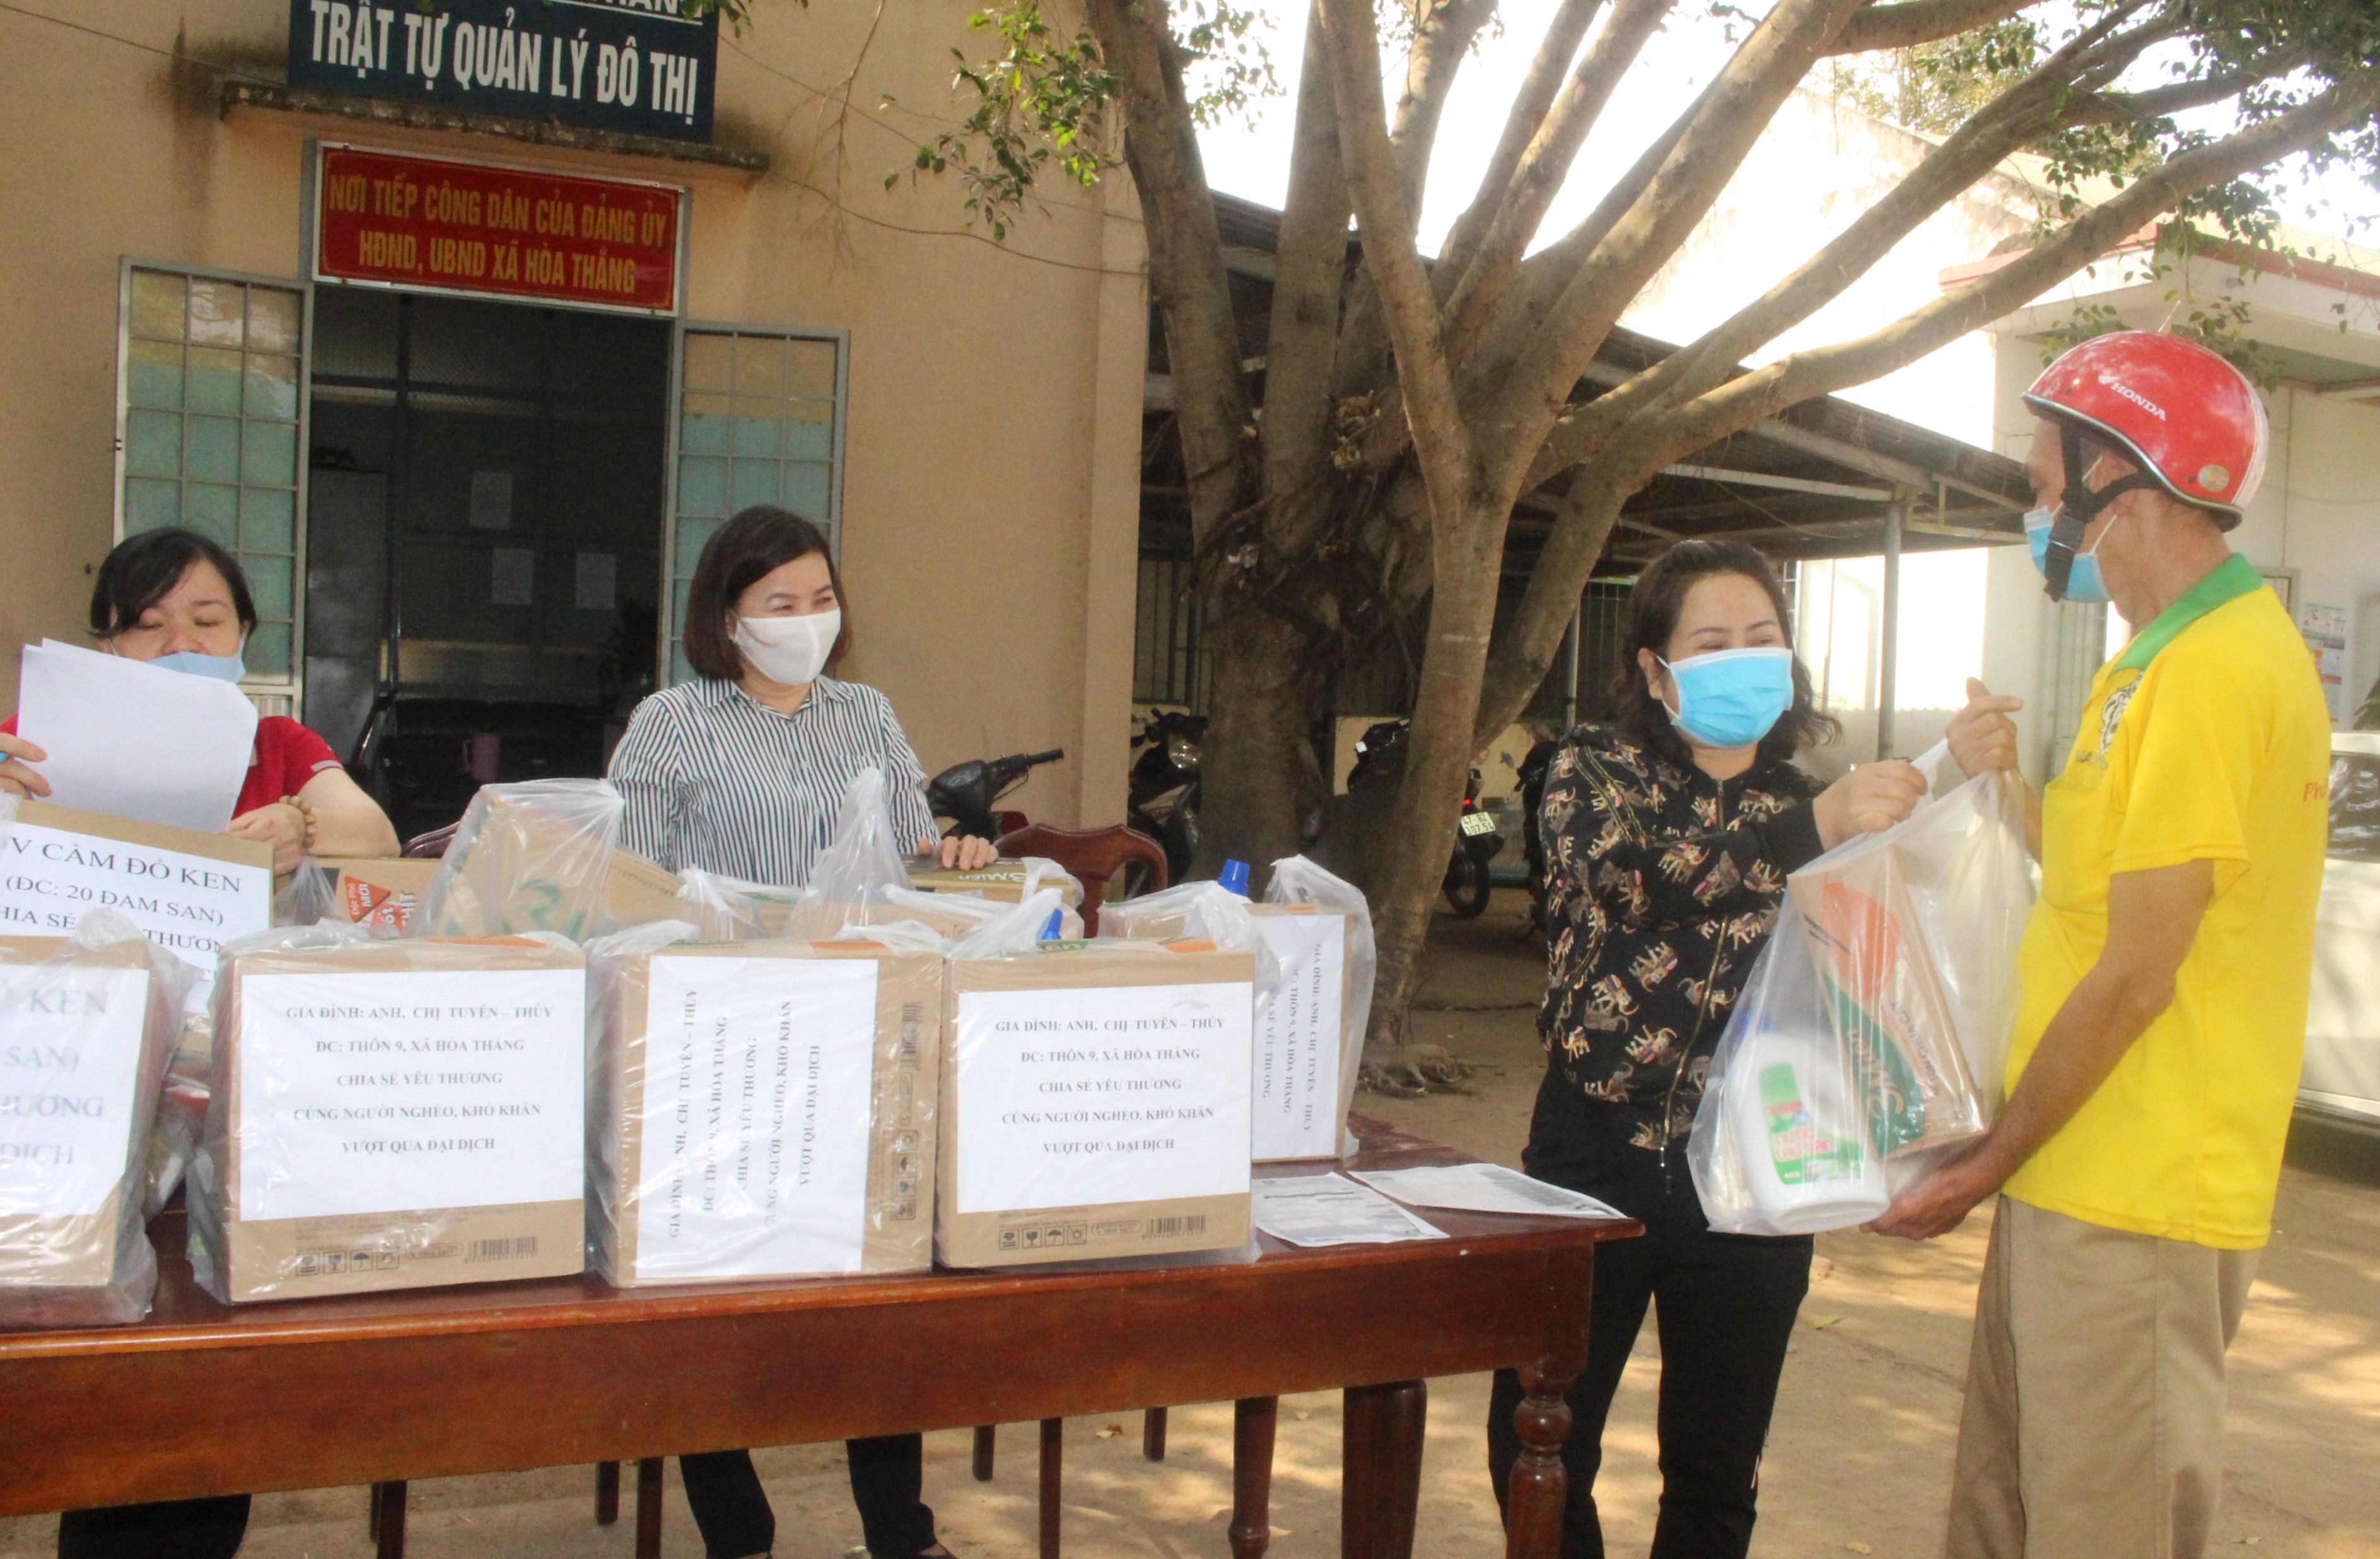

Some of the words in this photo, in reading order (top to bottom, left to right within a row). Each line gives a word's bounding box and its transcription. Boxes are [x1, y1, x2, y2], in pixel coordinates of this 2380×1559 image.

[310, 0, 394, 79] TRẬT
[404, 12, 450, 91] TỰ
[453, 6, 542, 93] QUẢN
[551, 28, 590, 100] LÝ
[597, 35, 639, 107] ĐÔ
[650, 51, 698, 126] THỊ
[329, 175, 368, 214] NƠI
[373, 172, 418, 218] TIẾP
[425, 179, 481, 226] CÔNG
[487, 188, 530, 232] DÂN
[536, 189, 576, 237] CỦA
[581, 192, 636, 245] ĐẢNG
[641, 199, 667, 247] ỦY
[429, 236, 486, 277] UBND
[491, 240, 519, 282] XÃ
[525, 242, 566, 286] HÒA
[571, 245, 636, 294] THẮNG
[2111, 381, 2167, 422] HONDA
[42, 842, 116, 870] CẦM
[125, 857, 170, 880] ĐỒ
[180, 867, 242, 894] KEN
[66, 884, 93, 902] 20
[166, 902, 224, 926] SAN)
[30, 988, 110, 1015] KEN
[286, 1007, 315, 1019] GIA
[995, 1020, 1020, 1032] GIA
[337, 1074, 376, 1086] CHIA
[1039, 1081, 1073, 1093] CHIA
[803, 1112, 815, 1143] QUA
[390, 1140, 423, 1154] QUA
[1084, 1141, 1112, 1154] QUA
[668, 1213, 681, 1238] GIA
